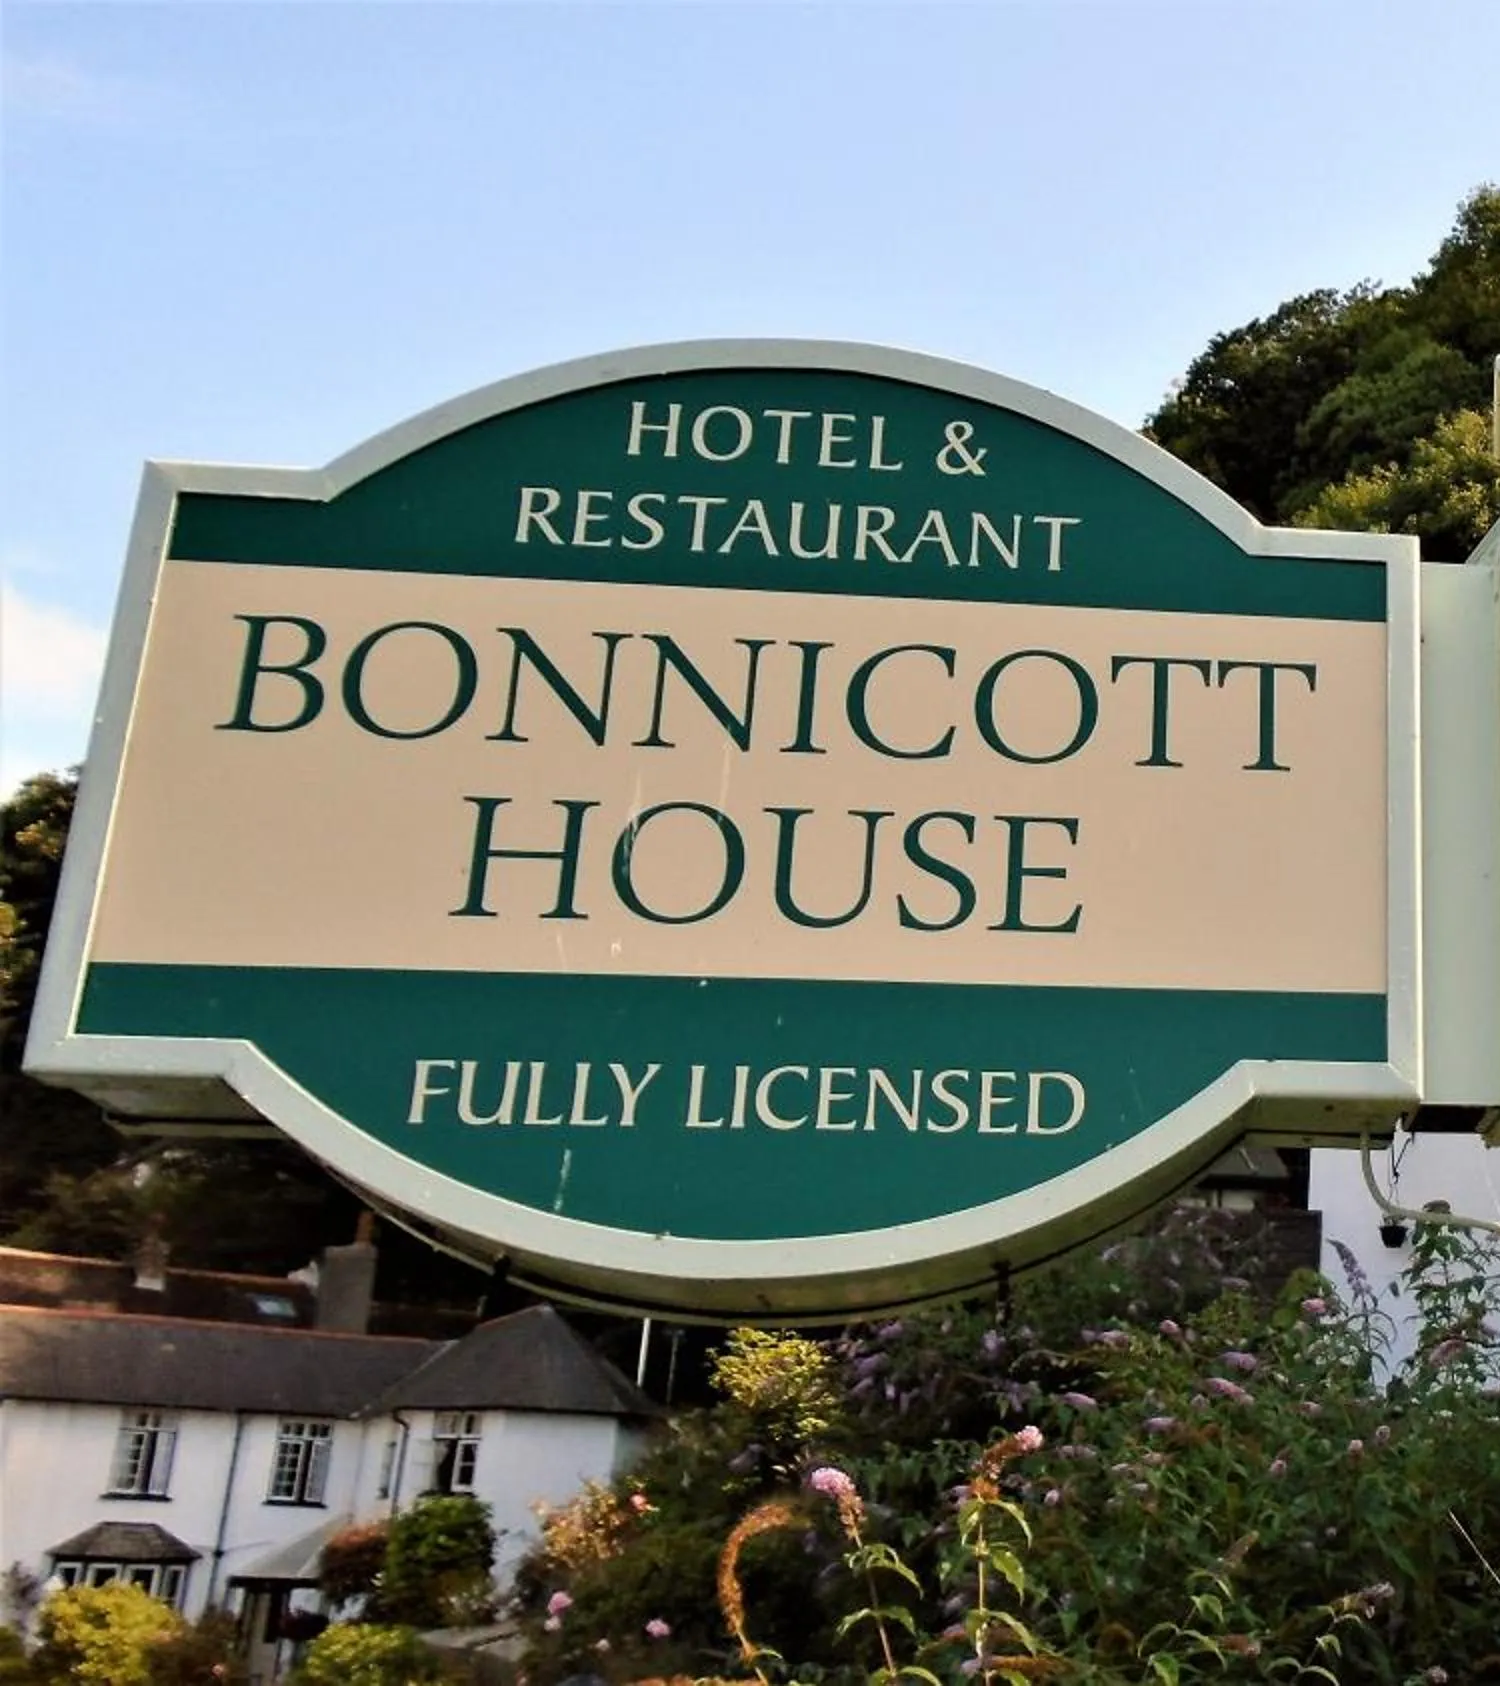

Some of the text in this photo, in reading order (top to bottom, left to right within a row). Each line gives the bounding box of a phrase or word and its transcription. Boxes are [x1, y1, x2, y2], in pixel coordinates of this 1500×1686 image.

[627, 401, 988, 476] HOTEL &
[516, 486, 1081, 573] RESTAURANT
[214, 614, 1318, 772] BONNICOTT
[449, 795, 1084, 933] HOUSE
[407, 1058, 1087, 1136] FULLY LICENSED
